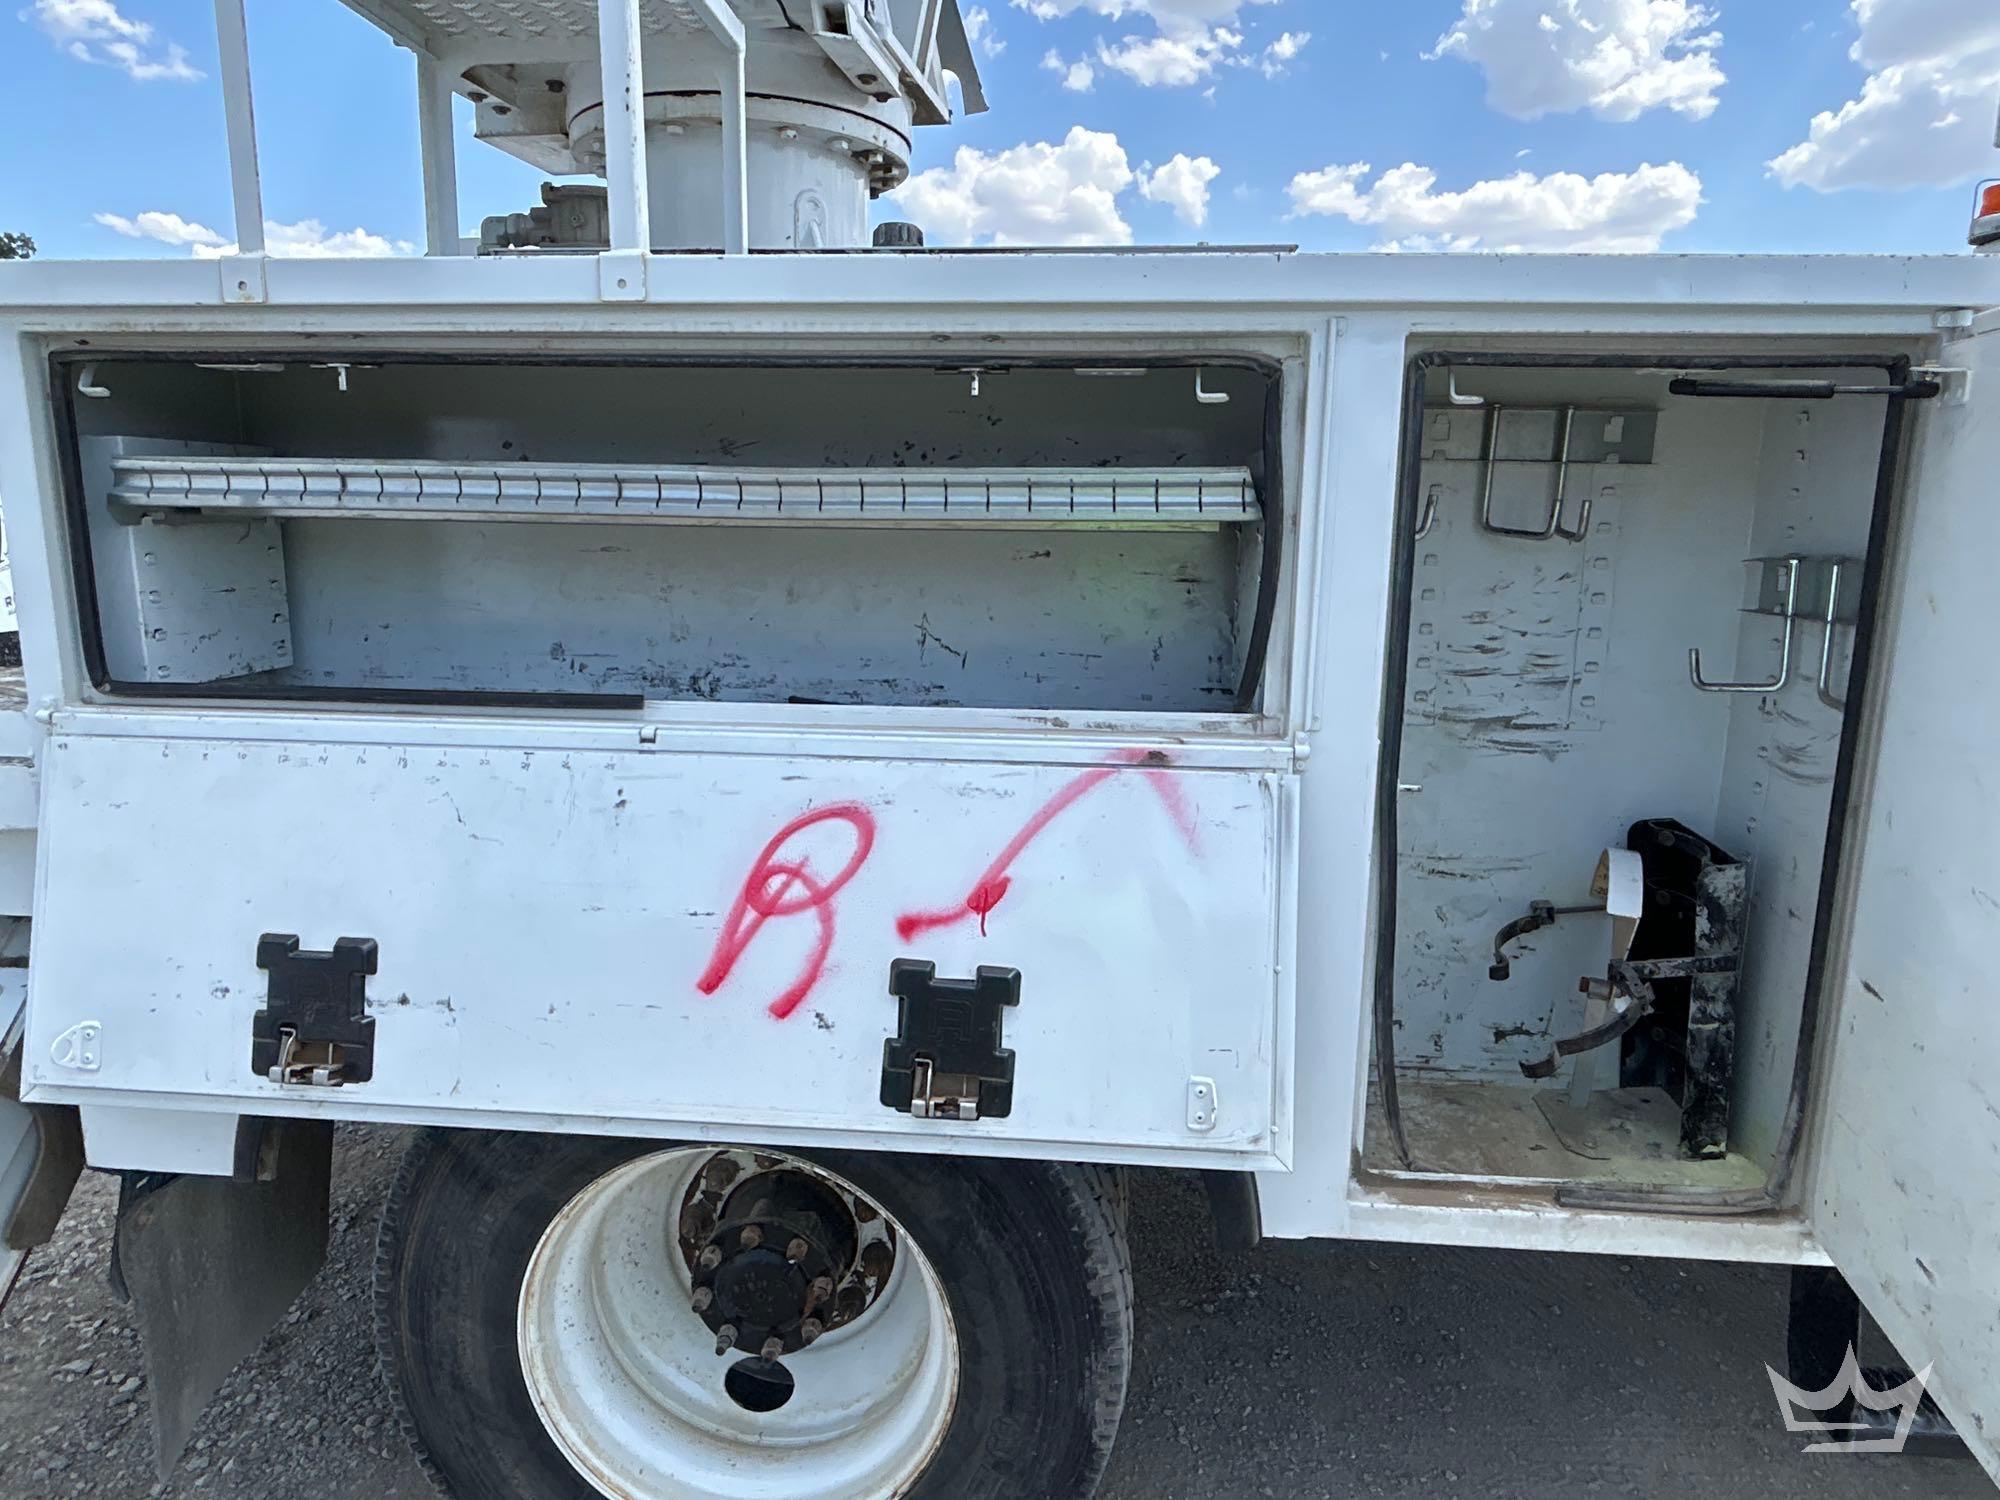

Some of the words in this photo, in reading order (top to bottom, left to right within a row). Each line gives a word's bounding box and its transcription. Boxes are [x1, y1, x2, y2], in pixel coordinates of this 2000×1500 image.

[277, 755, 290, 764] 12
[318, 755, 329, 766] 14
[397, 756, 408, 769] 18
